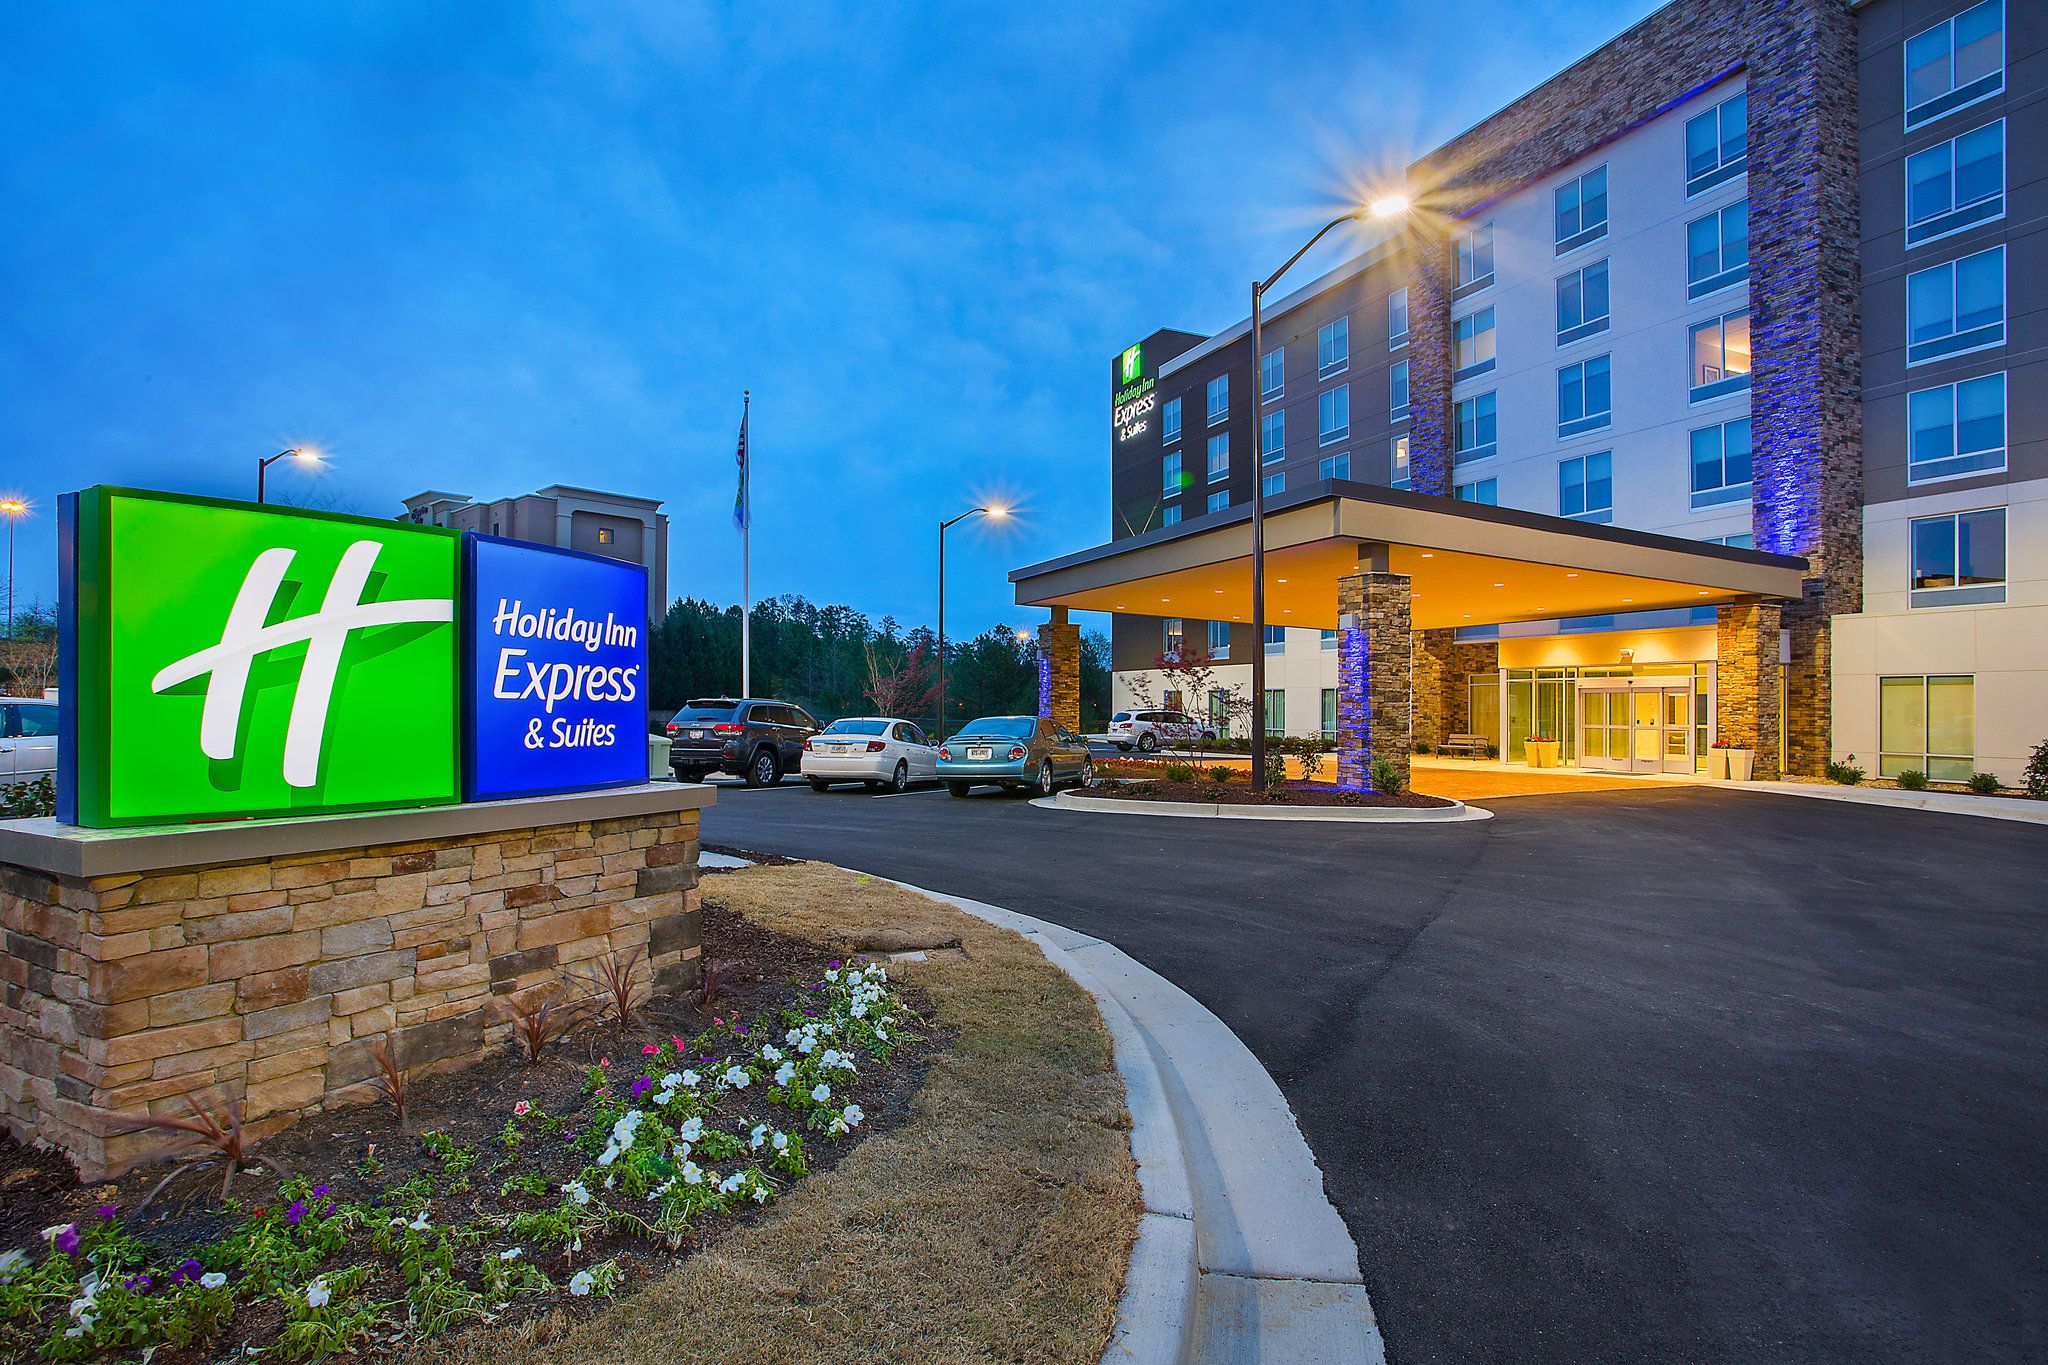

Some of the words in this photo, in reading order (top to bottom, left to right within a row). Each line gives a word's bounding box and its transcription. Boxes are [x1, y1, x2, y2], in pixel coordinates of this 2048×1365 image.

[1114, 384, 1141, 407] Holiday
[1142, 377, 1155, 393] Inn
[1114, 393, 1155, 428] Express
[1120, 428, 1127, 442] &
[1126, 420, 1147, 439] Suites
[492, 598, 603, 652] Holiday
[604, 612, 637, 648] Inn
[493, 647, 638, 714] Express
[524, 717, 544, 749] &
[549, 717, 616, 748] Suites
